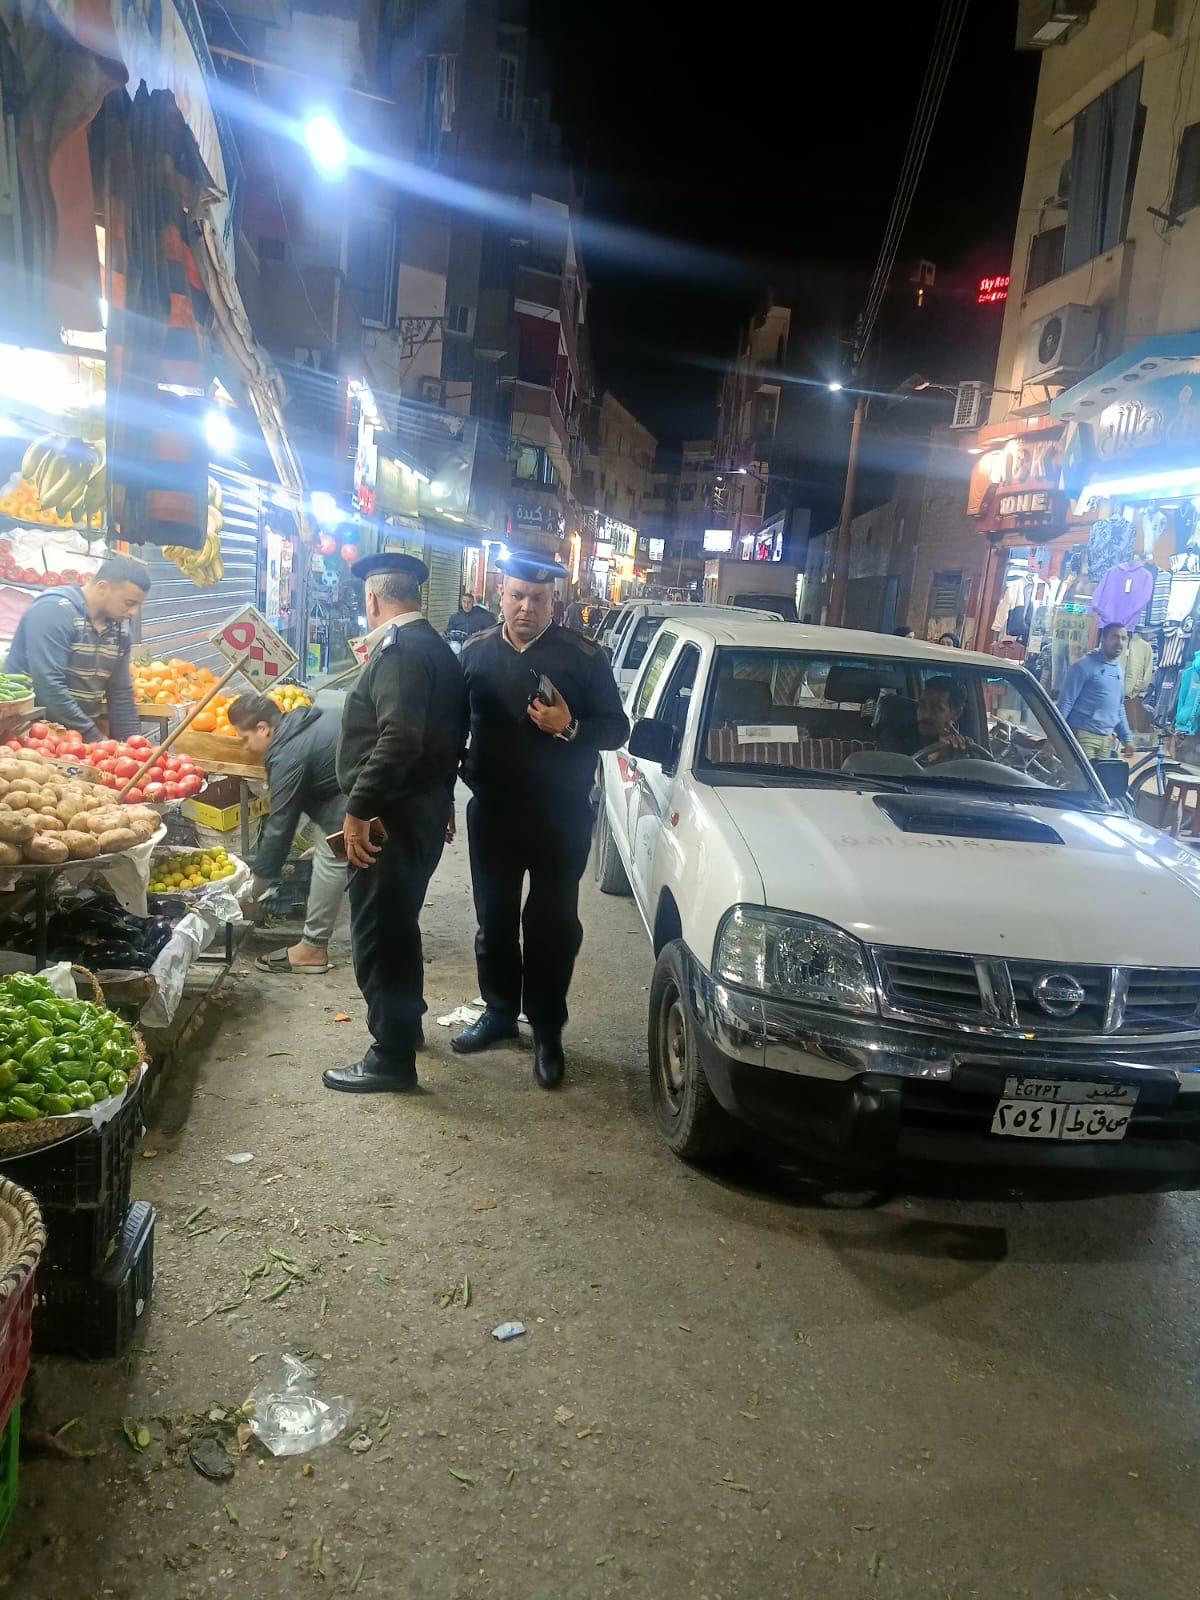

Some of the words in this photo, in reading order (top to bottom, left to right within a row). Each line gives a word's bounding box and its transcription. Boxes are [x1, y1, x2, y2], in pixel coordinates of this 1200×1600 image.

[517, 504, 543, 524] كبدة
[1016, 1083, 1061, 1099] EGYPT
[1086, 1086, 1128, 1099] مصر
[997, 1104, 1057, 1134] ٢٥٤١
